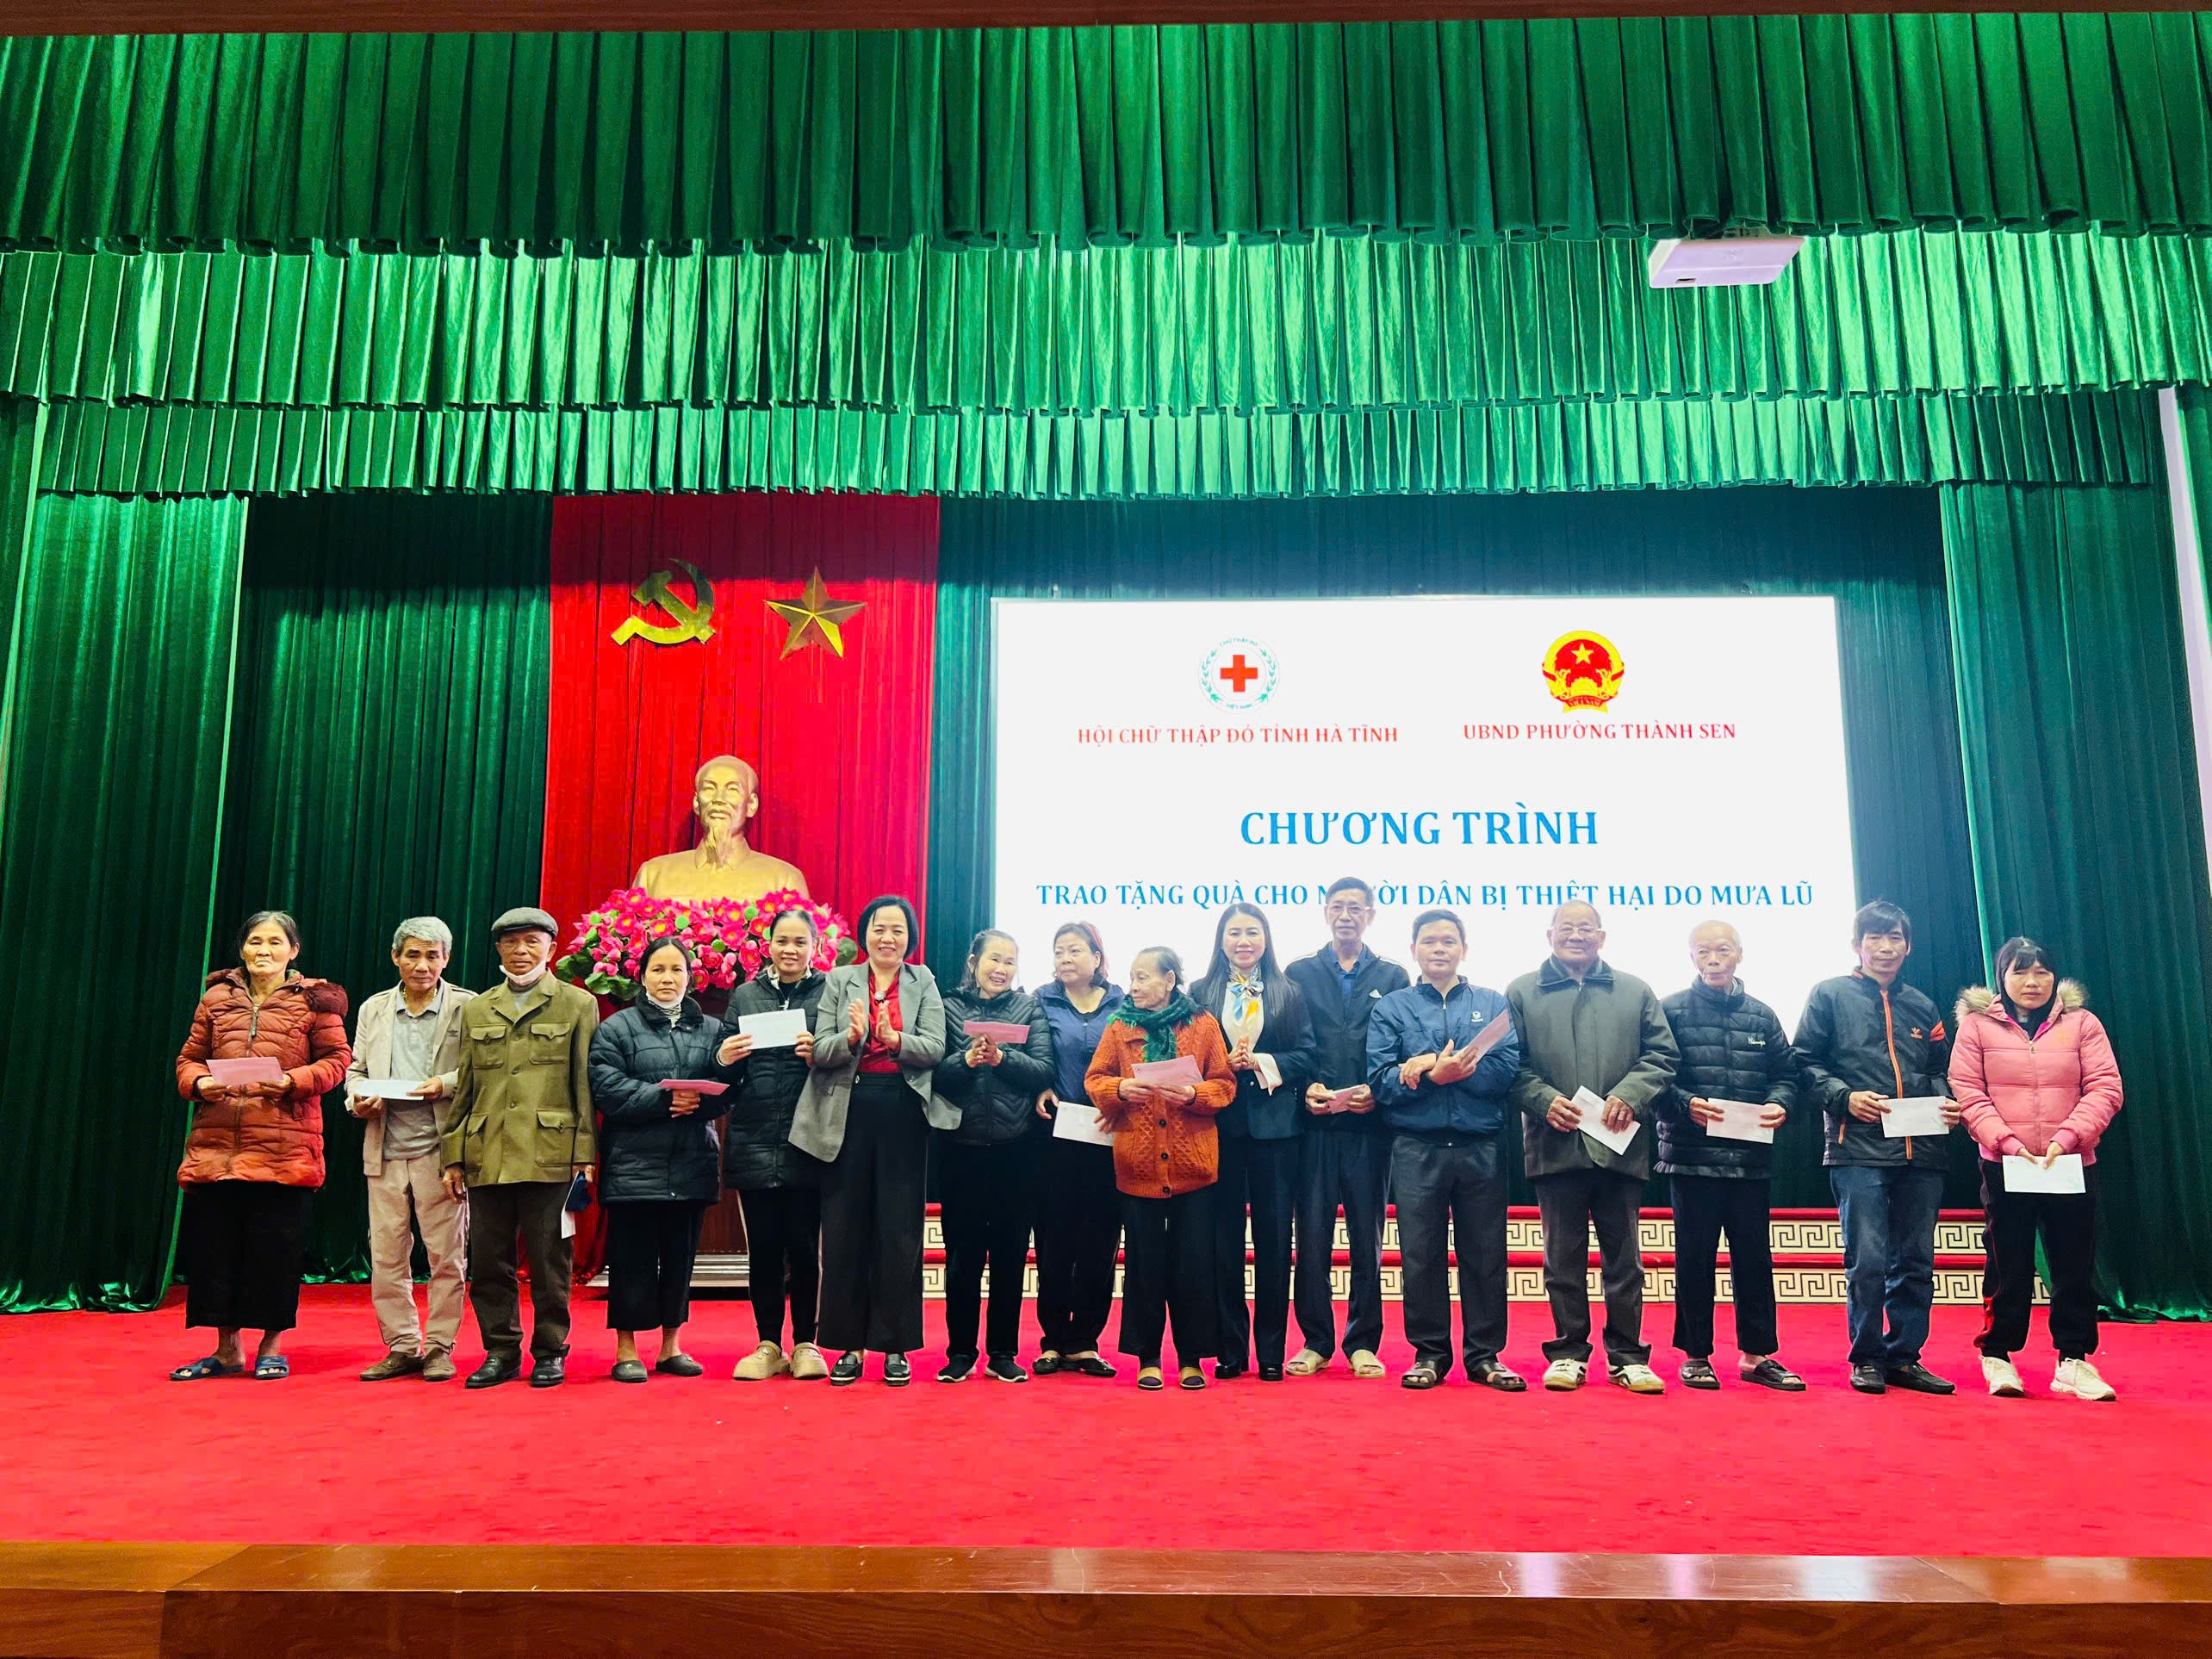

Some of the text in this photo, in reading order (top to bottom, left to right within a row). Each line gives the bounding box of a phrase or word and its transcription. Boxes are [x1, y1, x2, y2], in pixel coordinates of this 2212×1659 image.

[1078, 723, 1397, 747] HỘI CHỮ THẬP ĐỎ TỈNH HÀ TĨNH
[1463, 720, 1735, 739] UBND PHƯỜNG THÀNH SEN
[1240, 801, 1599, 845] CHƯƠNG TRÌNH
[1036, 885, 1107, 905] TRAO
[1116, 879, 1184, 910] TẶNG
[1193, 879, 1245, 910] QUÀ
[1254, 885, 1308, 905] CHO
[1318, 879, 1407, 905] NỜI
[1419, 879, 1471, 905] DÂN
[1482, 885, 1507, 910] BỊ
[1608, 885, 1654, 910] HẠI
[1664, 885, 1702, 906] DO
[1711, 885, 1772, 905] MƯA
[1781, 880, 1812, 905] LŨ
